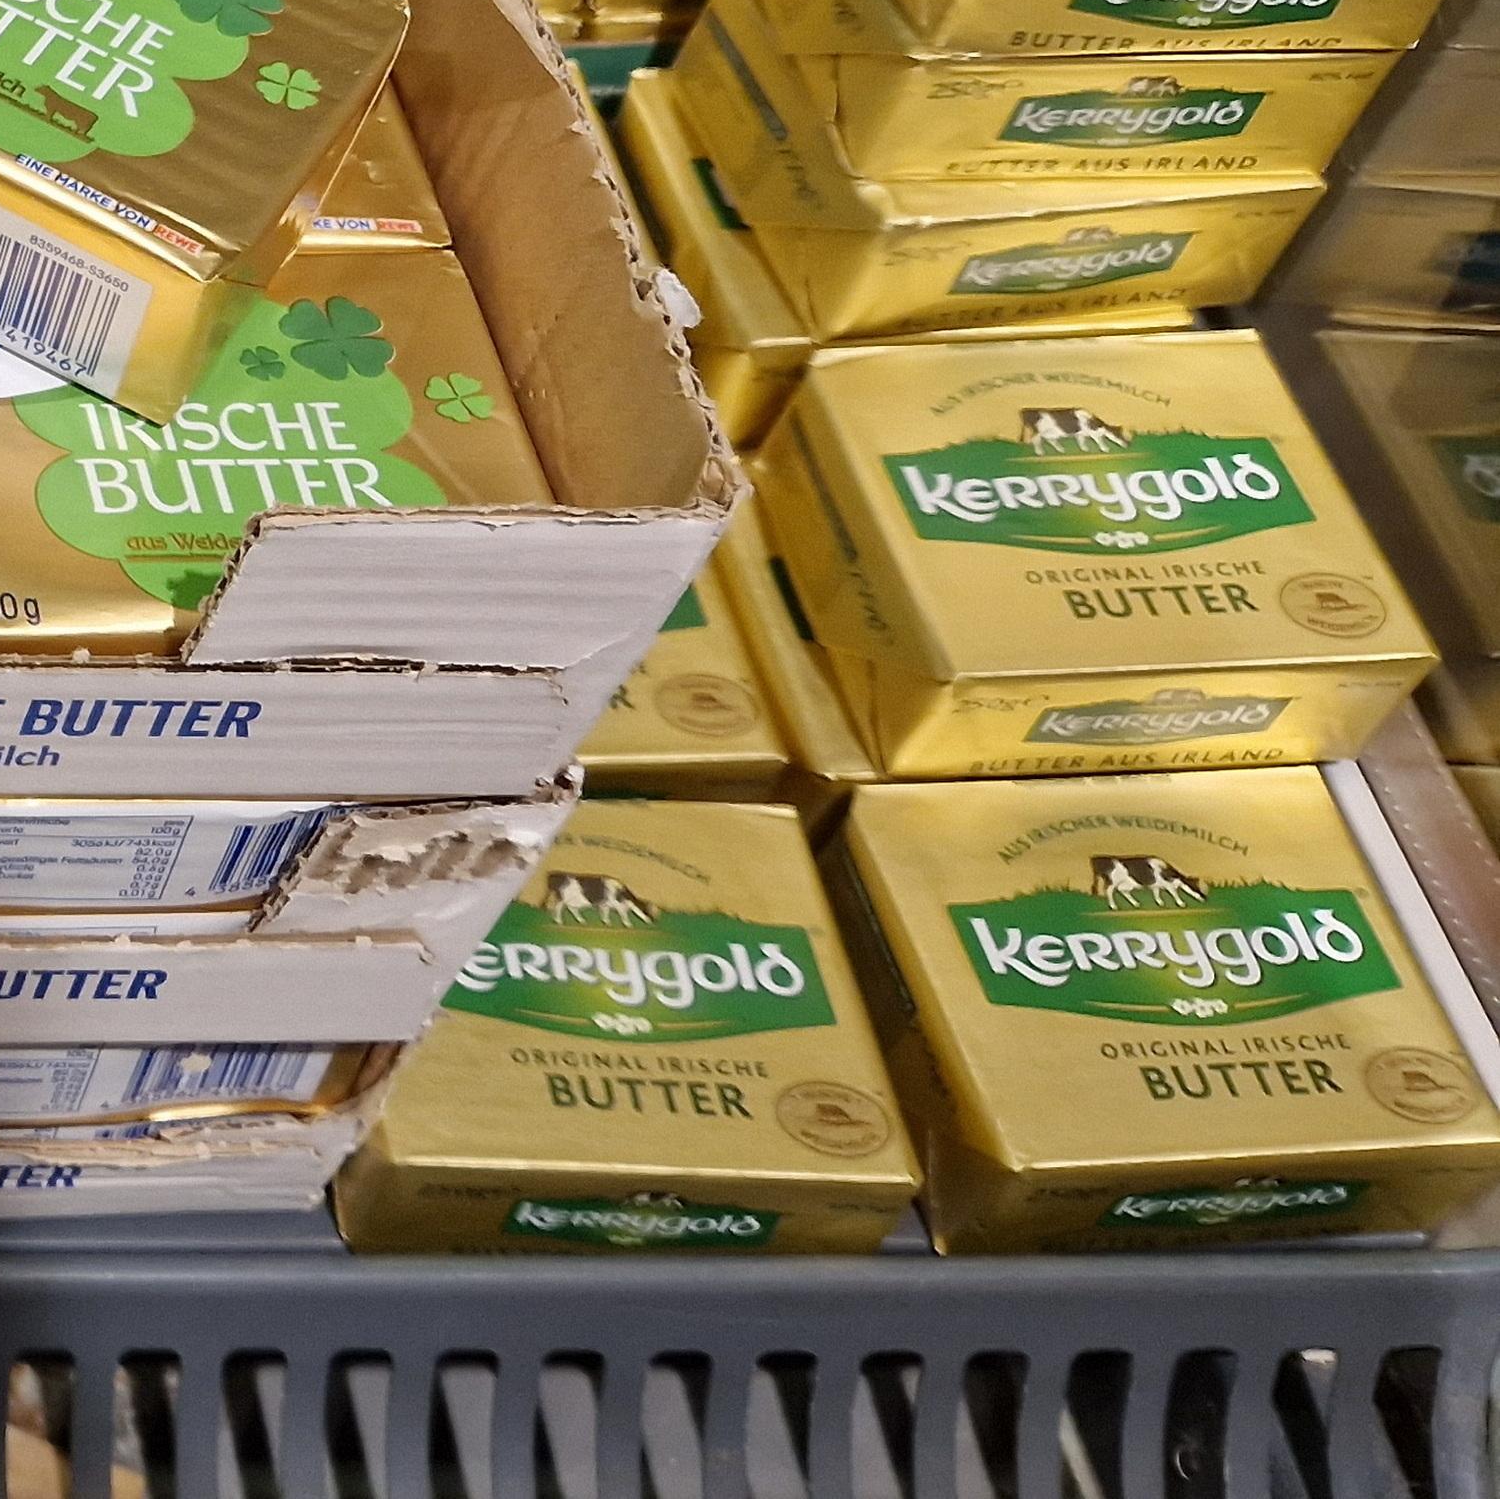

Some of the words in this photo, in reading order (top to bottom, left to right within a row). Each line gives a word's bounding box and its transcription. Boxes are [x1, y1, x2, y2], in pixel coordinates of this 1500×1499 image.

[16, 154, 56, 182] EINE
[53, 169, 113, 209] MARKE
[109, 203, 151, 231] VON
[153, 224, 202, 255] REWE
[30, 235, 128, 292] 8359468-S3650
[5, 329, 86, 377] 419467
[89, 458, 385, 514] BUTTER
[900, 453, 1281, 524] Kerrygold
[1026, 563, 1154, 586] ORIGINAL
[1163, 560, 1267, 580] IRISCHE
[24, 598, 42, 625] g
[1067, 584, 1260, 621] BUTTER
[21, 701, 263, 737] BUTTER
[978, 911, 1364, 988] Kerrygold
[1102, 1038, 1238, 1060] ORIGINAL
[1243, 1033, 1352, 1053] IRISCHE
[547, 1075, 753, 1120] BUTTER
[1145, 1060, 1345, 1102] BUTTER
